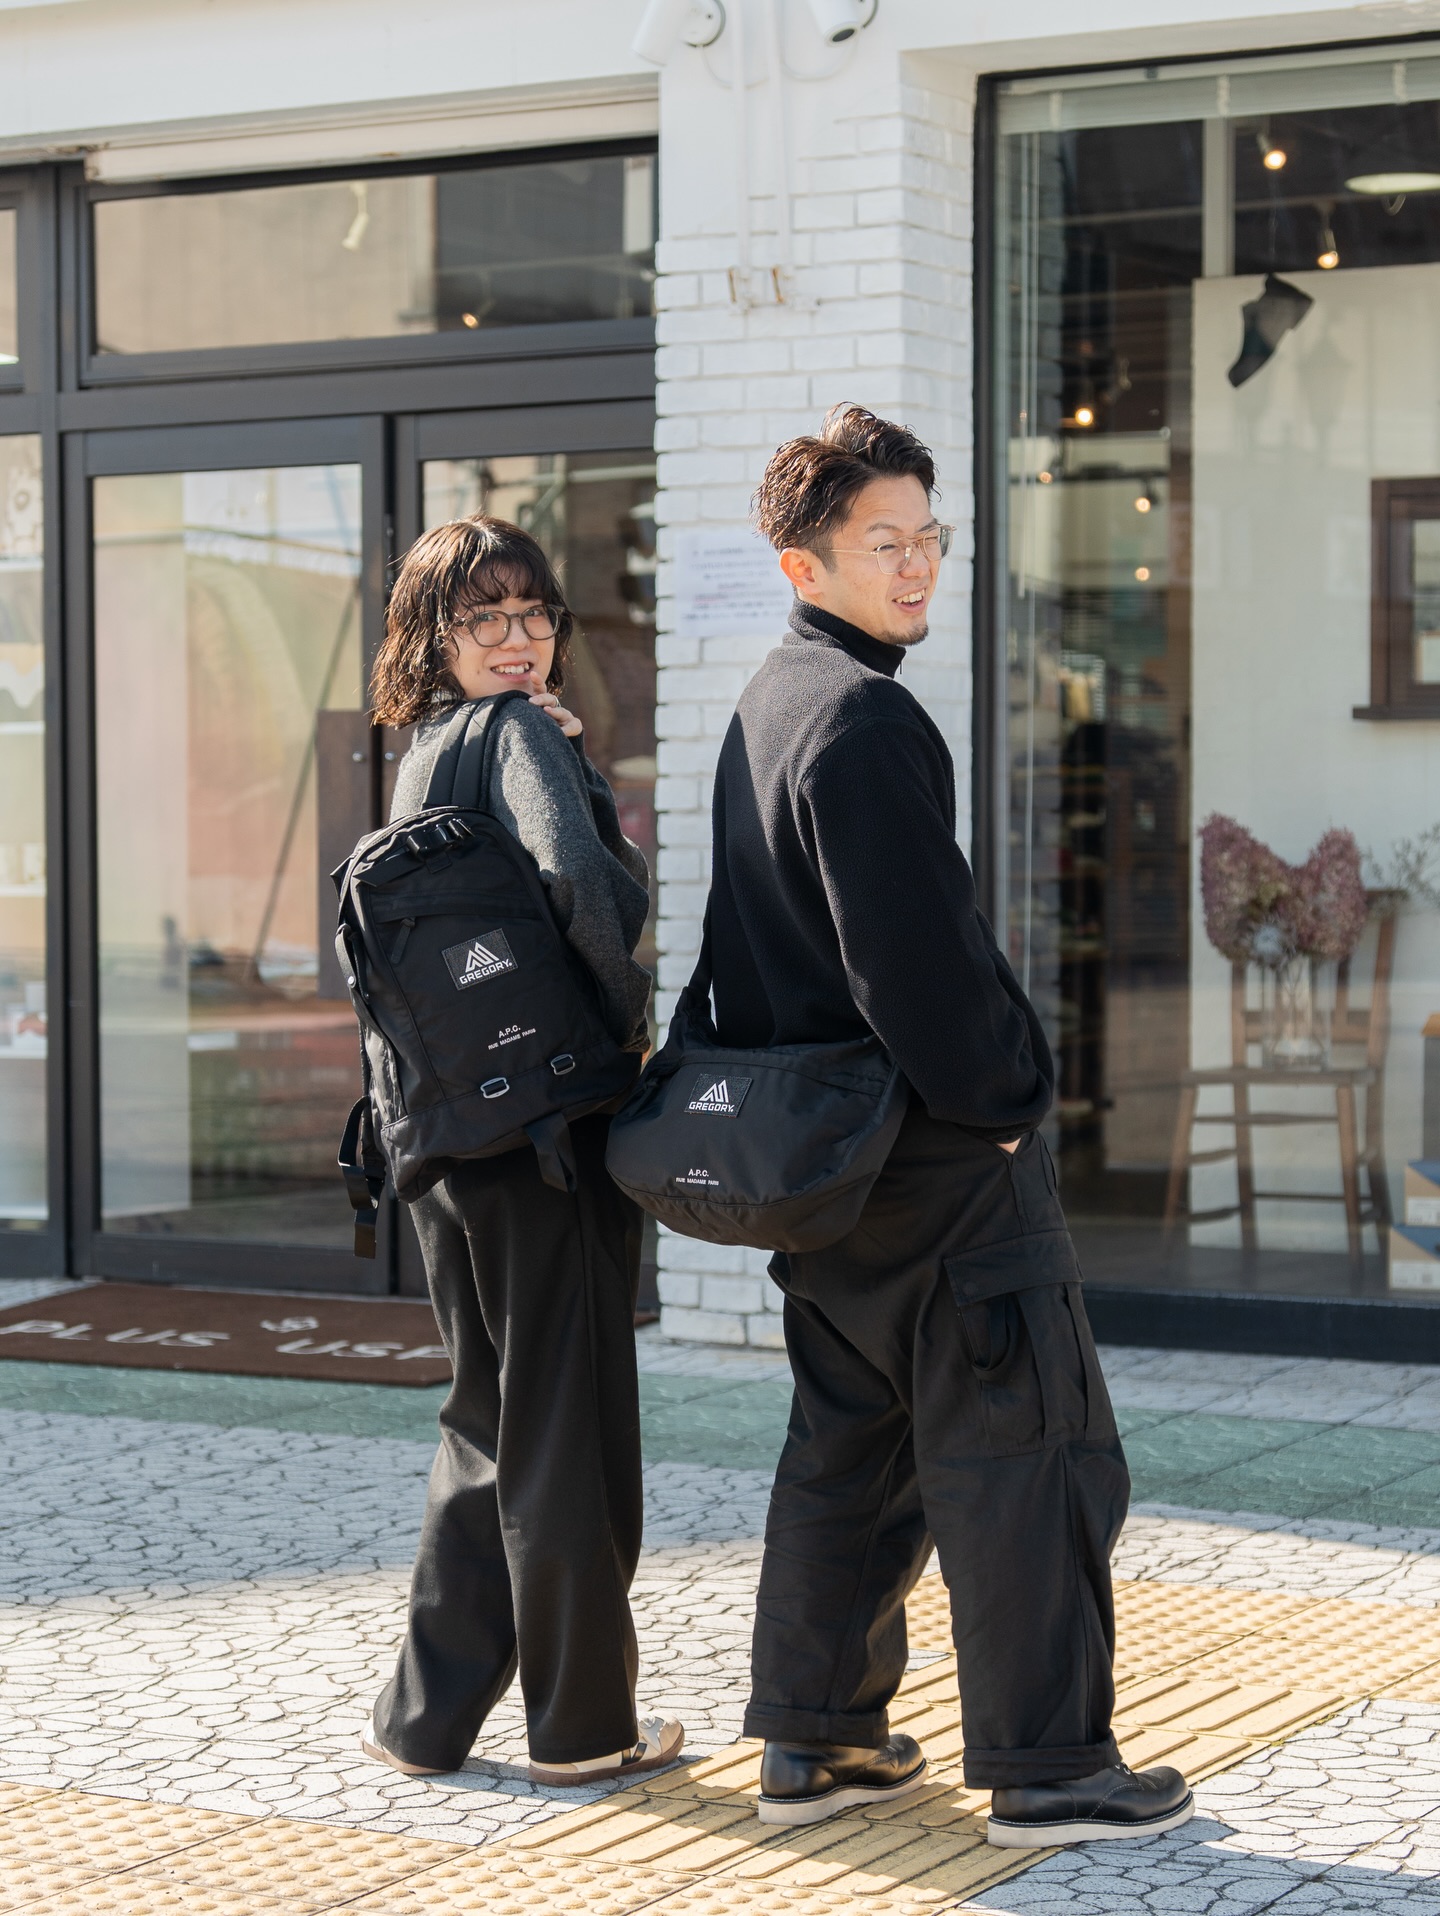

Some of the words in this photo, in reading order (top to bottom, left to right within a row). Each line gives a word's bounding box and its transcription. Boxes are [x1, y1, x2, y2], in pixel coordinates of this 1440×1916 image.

[498, 1024, 521, 1039] A.P.C.
[499, 1033, 521, 1046] MADAME
[522, 1028, 536, 1037] PARIS
[688, 1168, 710, 1177] A.P.C.
[0, 1319, 230, 1347] PLUS
